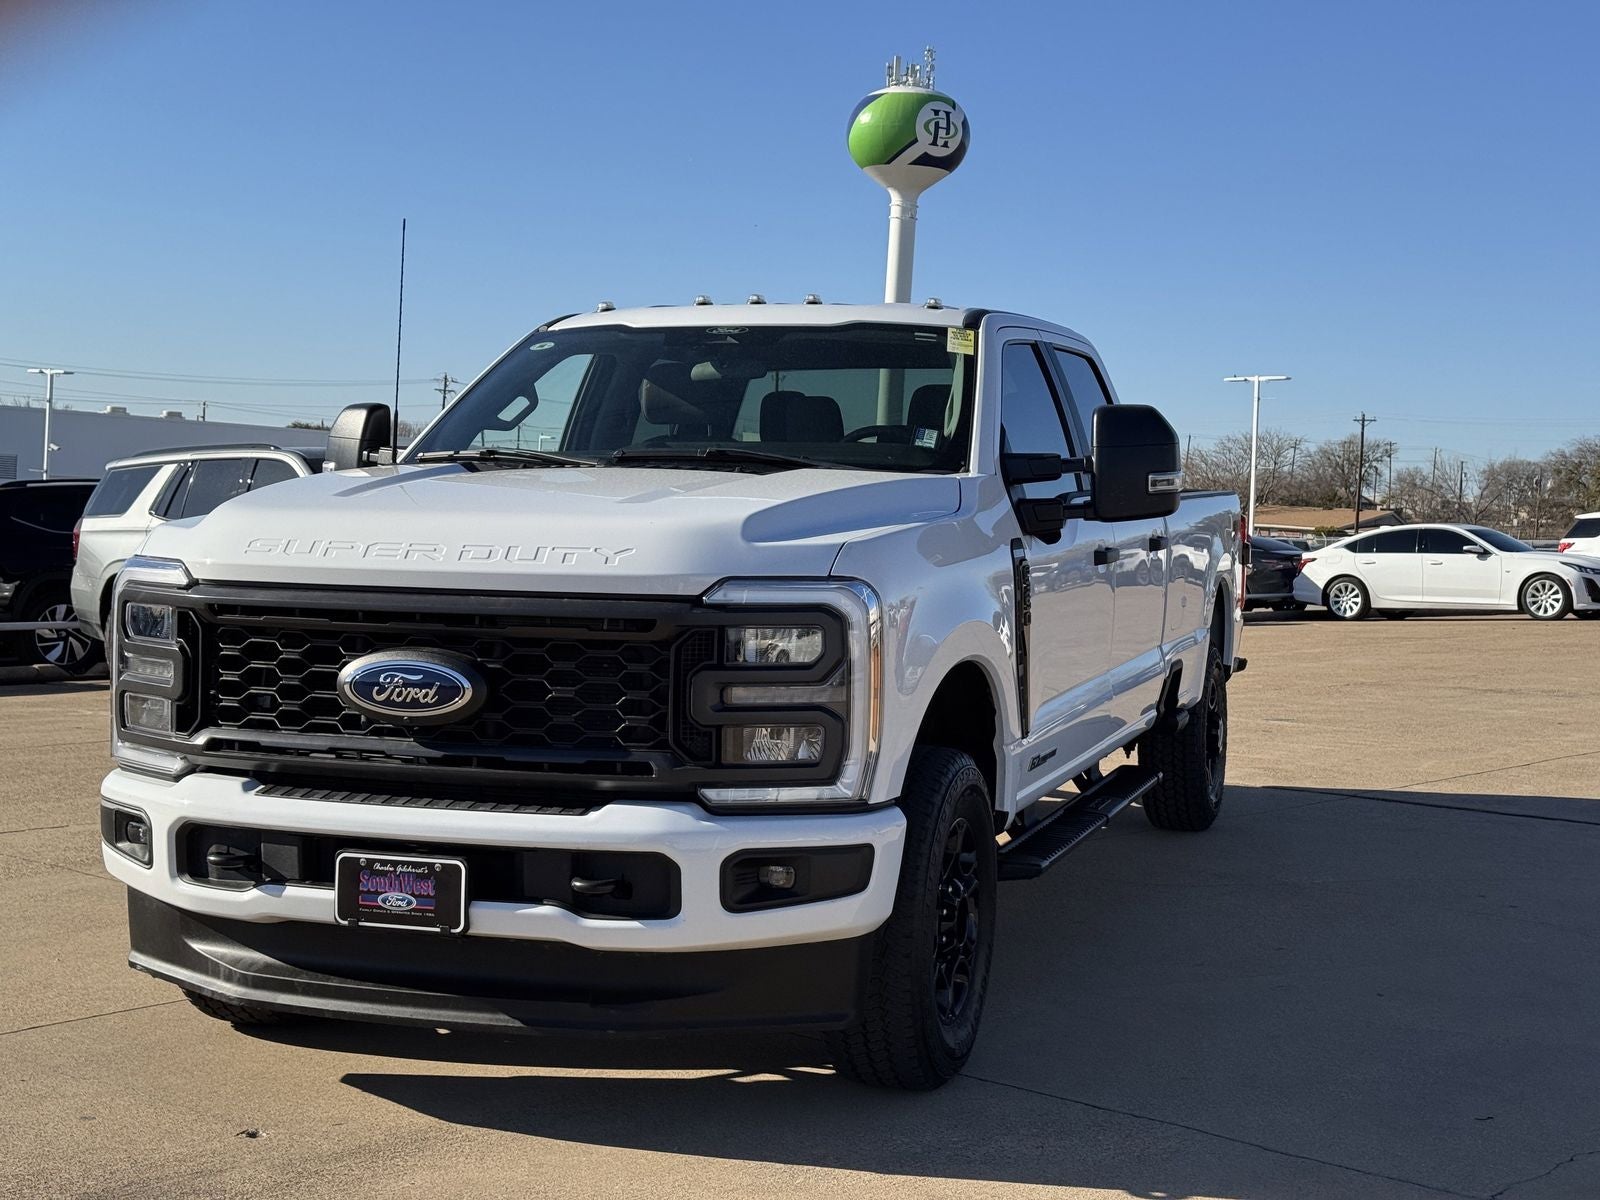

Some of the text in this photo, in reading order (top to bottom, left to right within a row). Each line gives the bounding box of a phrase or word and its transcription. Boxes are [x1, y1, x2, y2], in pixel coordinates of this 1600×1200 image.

[928, 108, 952, 148] H
[243, 537, 638, 567] SUPER DUTY
[372, 671, 441, 704] Ford
[386, 896, 408, 907] Ford
